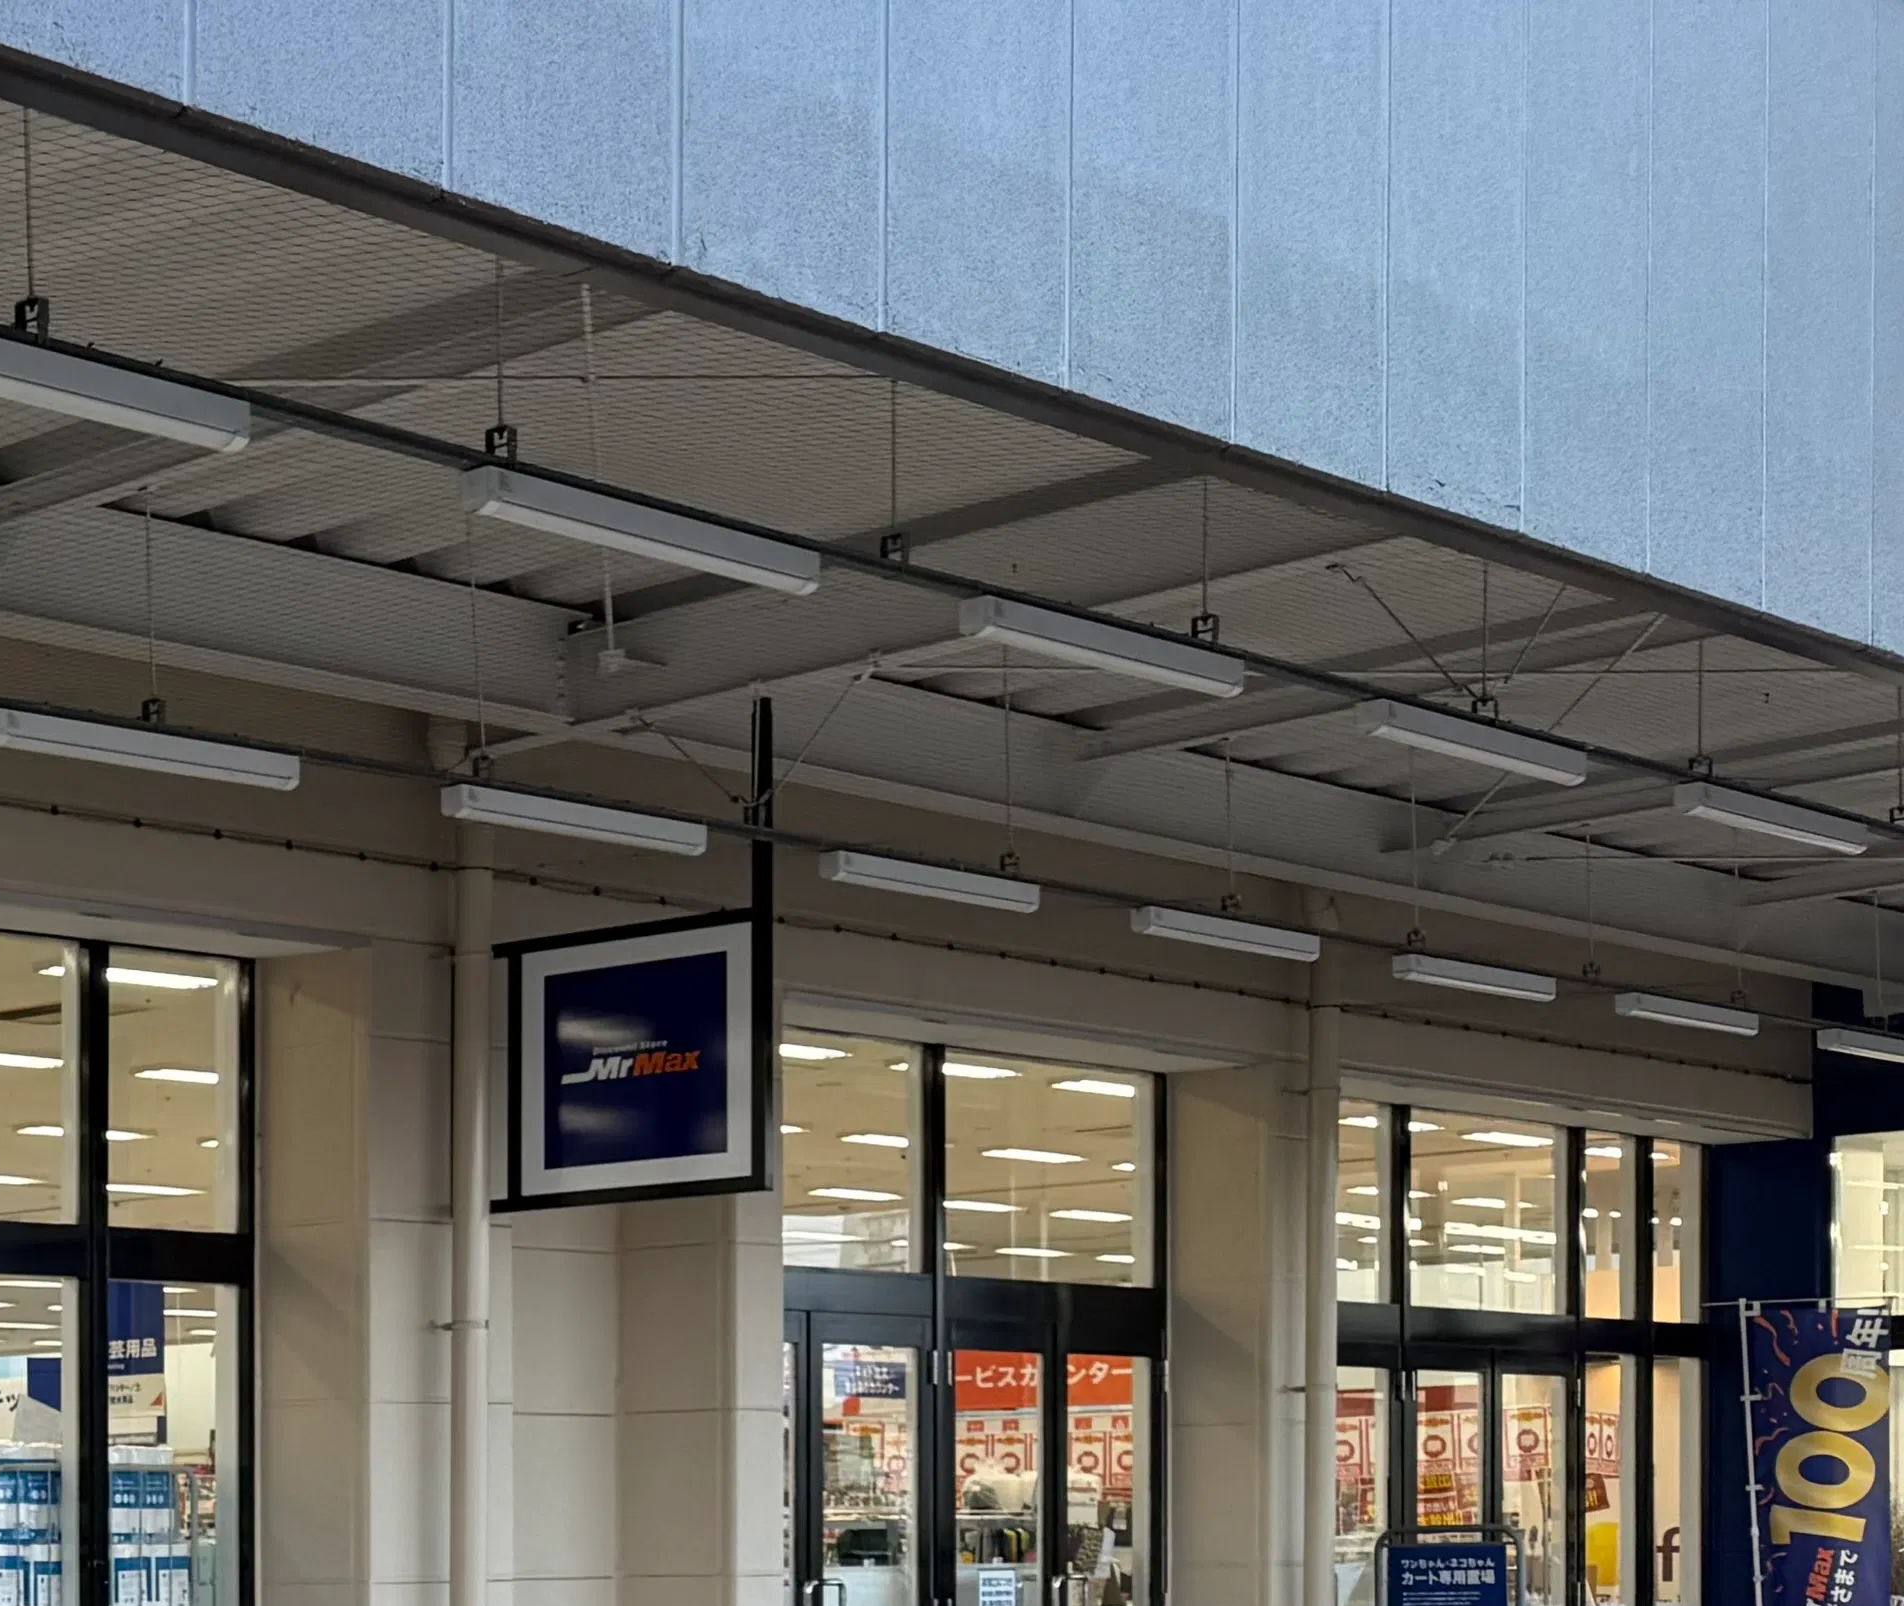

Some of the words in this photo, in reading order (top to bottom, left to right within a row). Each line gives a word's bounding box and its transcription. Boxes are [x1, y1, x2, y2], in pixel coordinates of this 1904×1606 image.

[640, 1039, 669, 1050] Store
[560, 1050, 702, 1085] MrMax
[1768, 1352, 1891, 1546] 100
